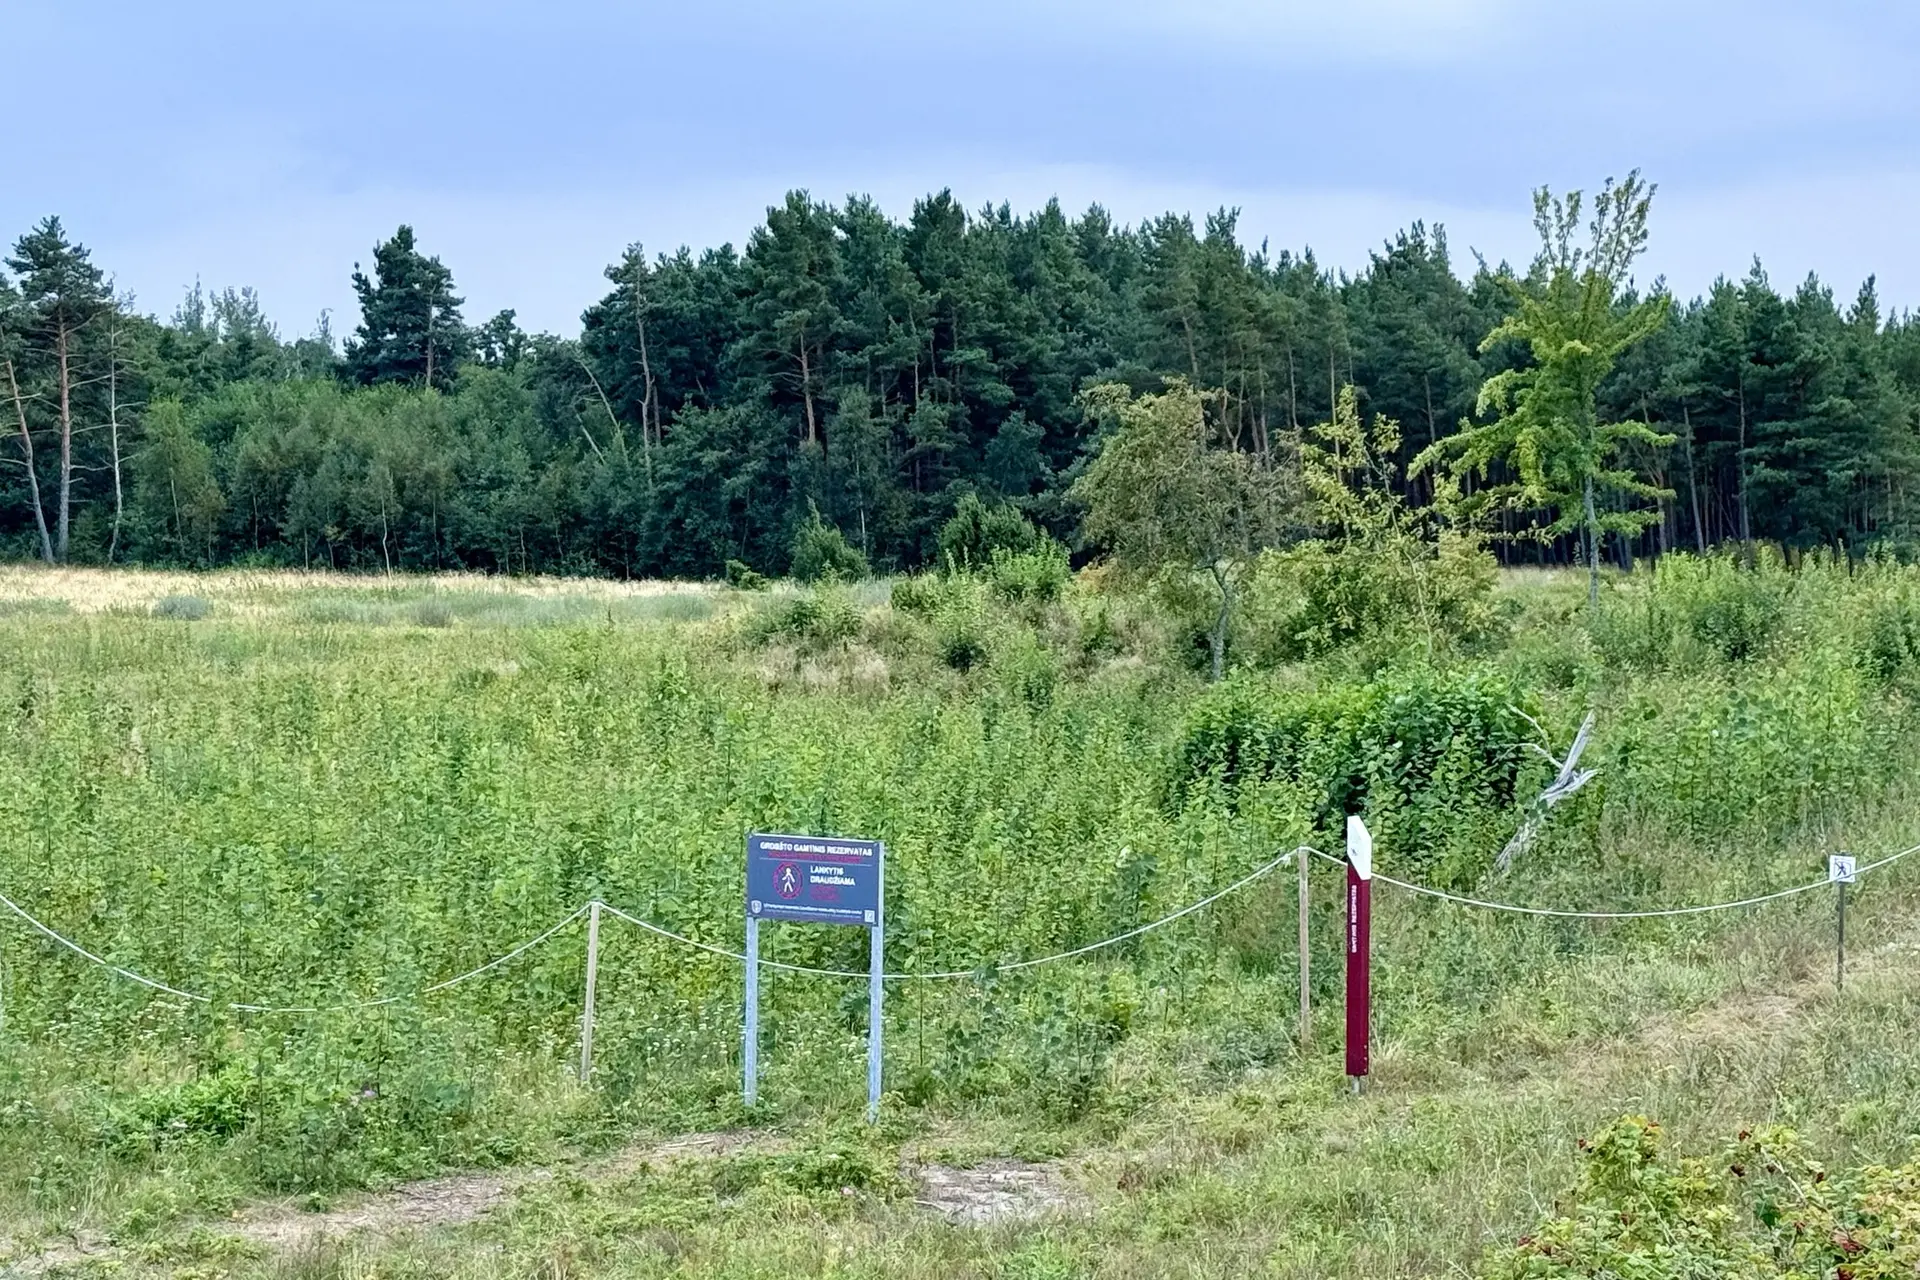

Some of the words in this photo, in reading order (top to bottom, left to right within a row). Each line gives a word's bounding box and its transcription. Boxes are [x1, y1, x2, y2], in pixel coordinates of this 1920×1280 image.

[827, 845, 873, 857] REZERVATAS
[810, 865, 844, 875] LANKYTIS
[810, 875, 856, 886] DRAUDŽIAMA
